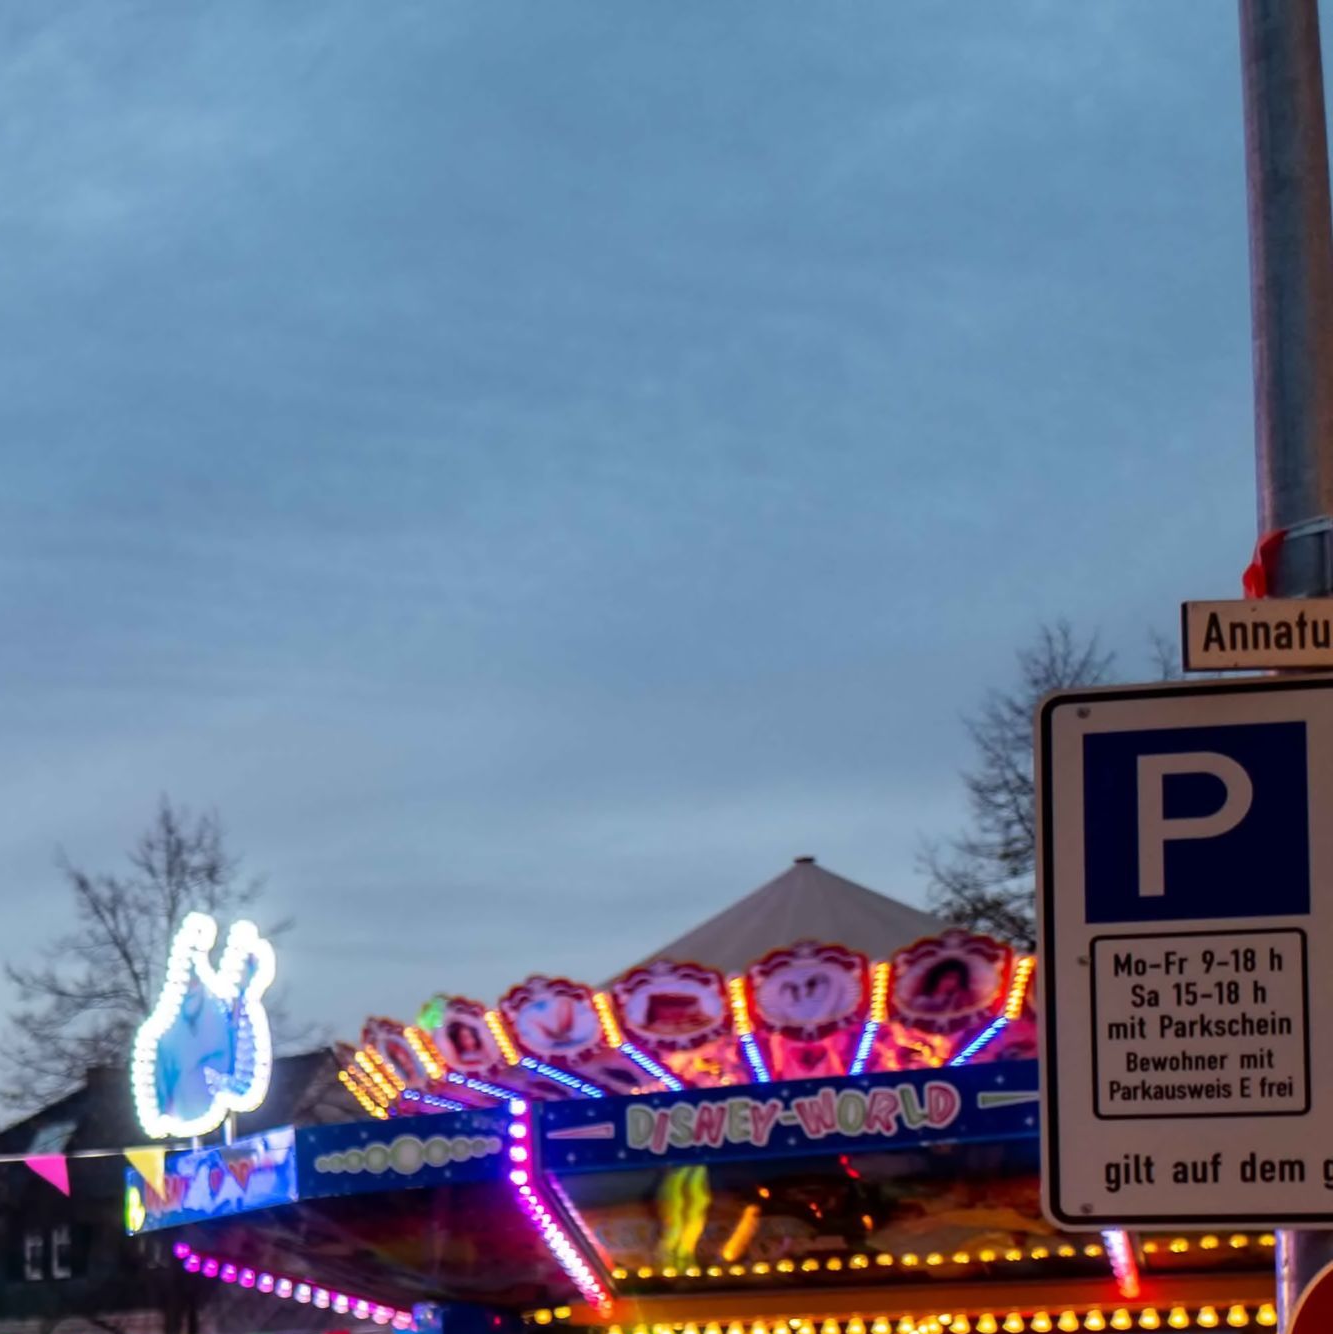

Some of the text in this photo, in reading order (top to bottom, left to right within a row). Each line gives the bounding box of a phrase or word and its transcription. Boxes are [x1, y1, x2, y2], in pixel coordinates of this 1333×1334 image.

[1136, 751, 1254, 898] P
[1113, 947, 1283, 978] Mo-Fr 9-18 h
[1131, 980, 1267, 1008] Sa 15-18 h
[1108, 1011, 1293, 1041] mit Parkschein
[1126, 1048, 1275, 1073] Bewohner mit
[1109, 1075, 1294, 1101] Parkausweis E frei
[626, 1081, 962, 1154] DISNEY-WORLD
[1105, 1154, 1155, 1194] gilt
[1172, 1153, 1222, 1185] auf
[1240, 1152, 1306, 1184] dem
